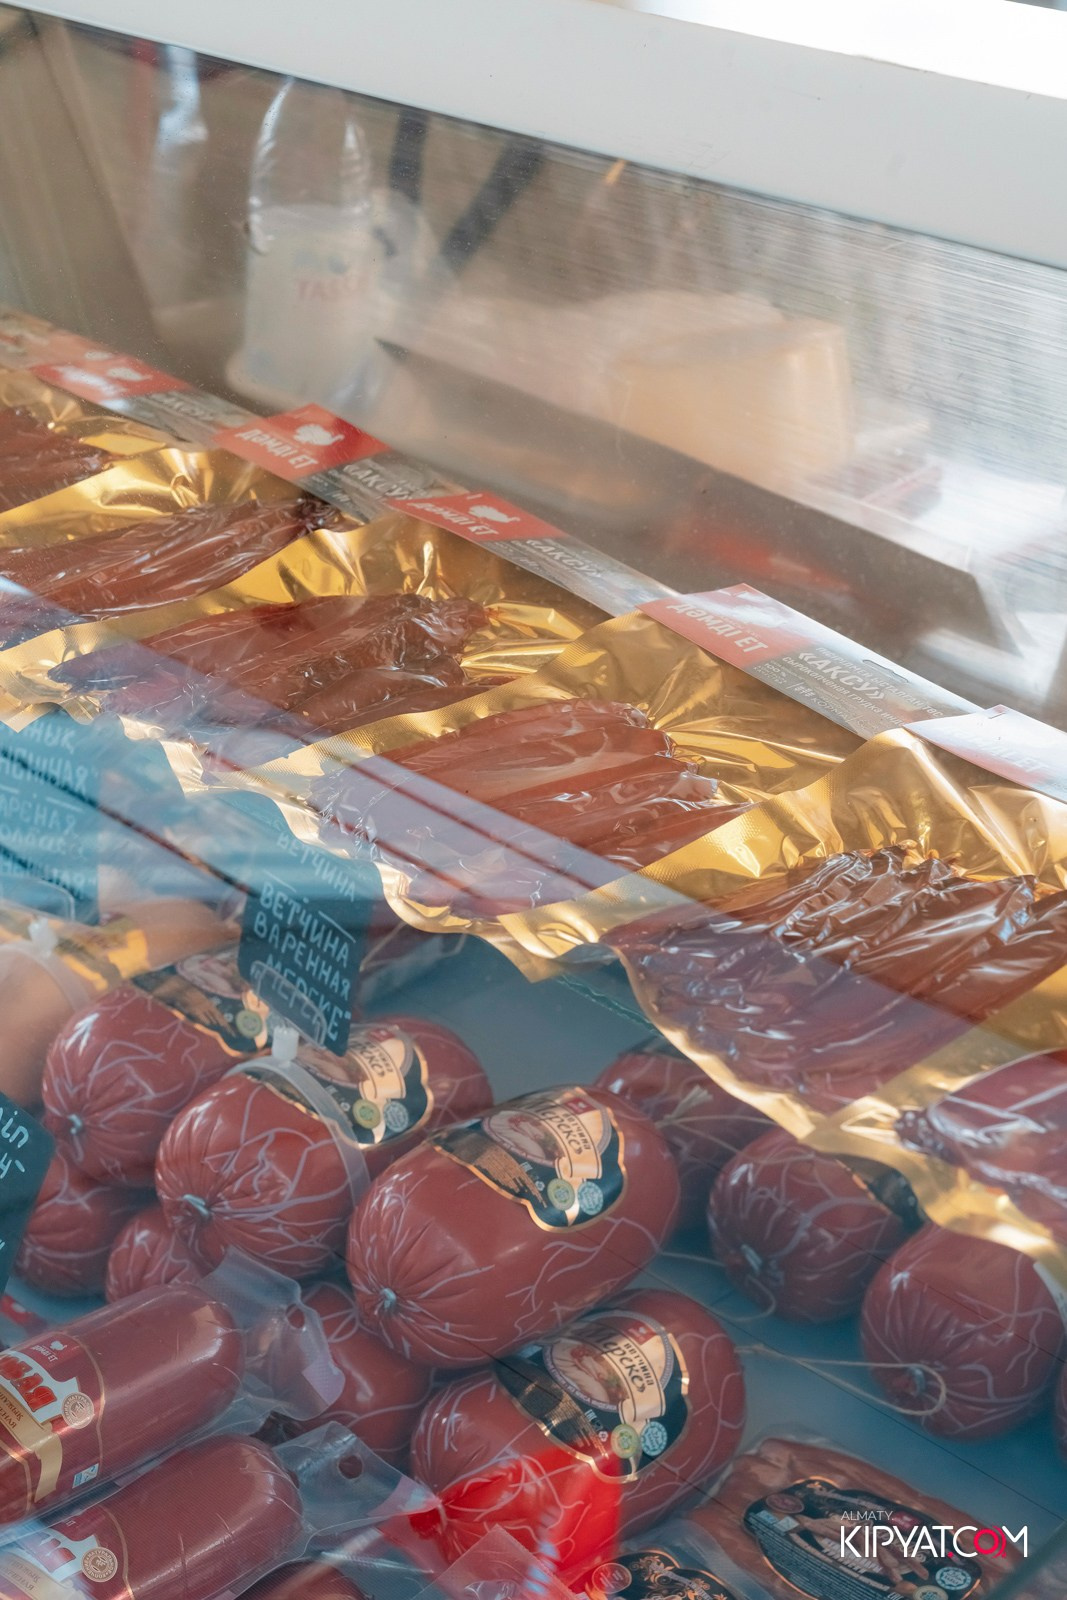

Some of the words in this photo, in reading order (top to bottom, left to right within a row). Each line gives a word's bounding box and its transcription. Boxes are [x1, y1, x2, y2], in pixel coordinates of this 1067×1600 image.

[288, 454, 318, 469] ЕТ
[467, 525, 499, 536] ЕТ
[734, 636, 768, 653] ЕТ
[260, 882, 350, 968] ВЕТЧИНА
[253, 911, 351, 1000] ВАРЕННАЯ
